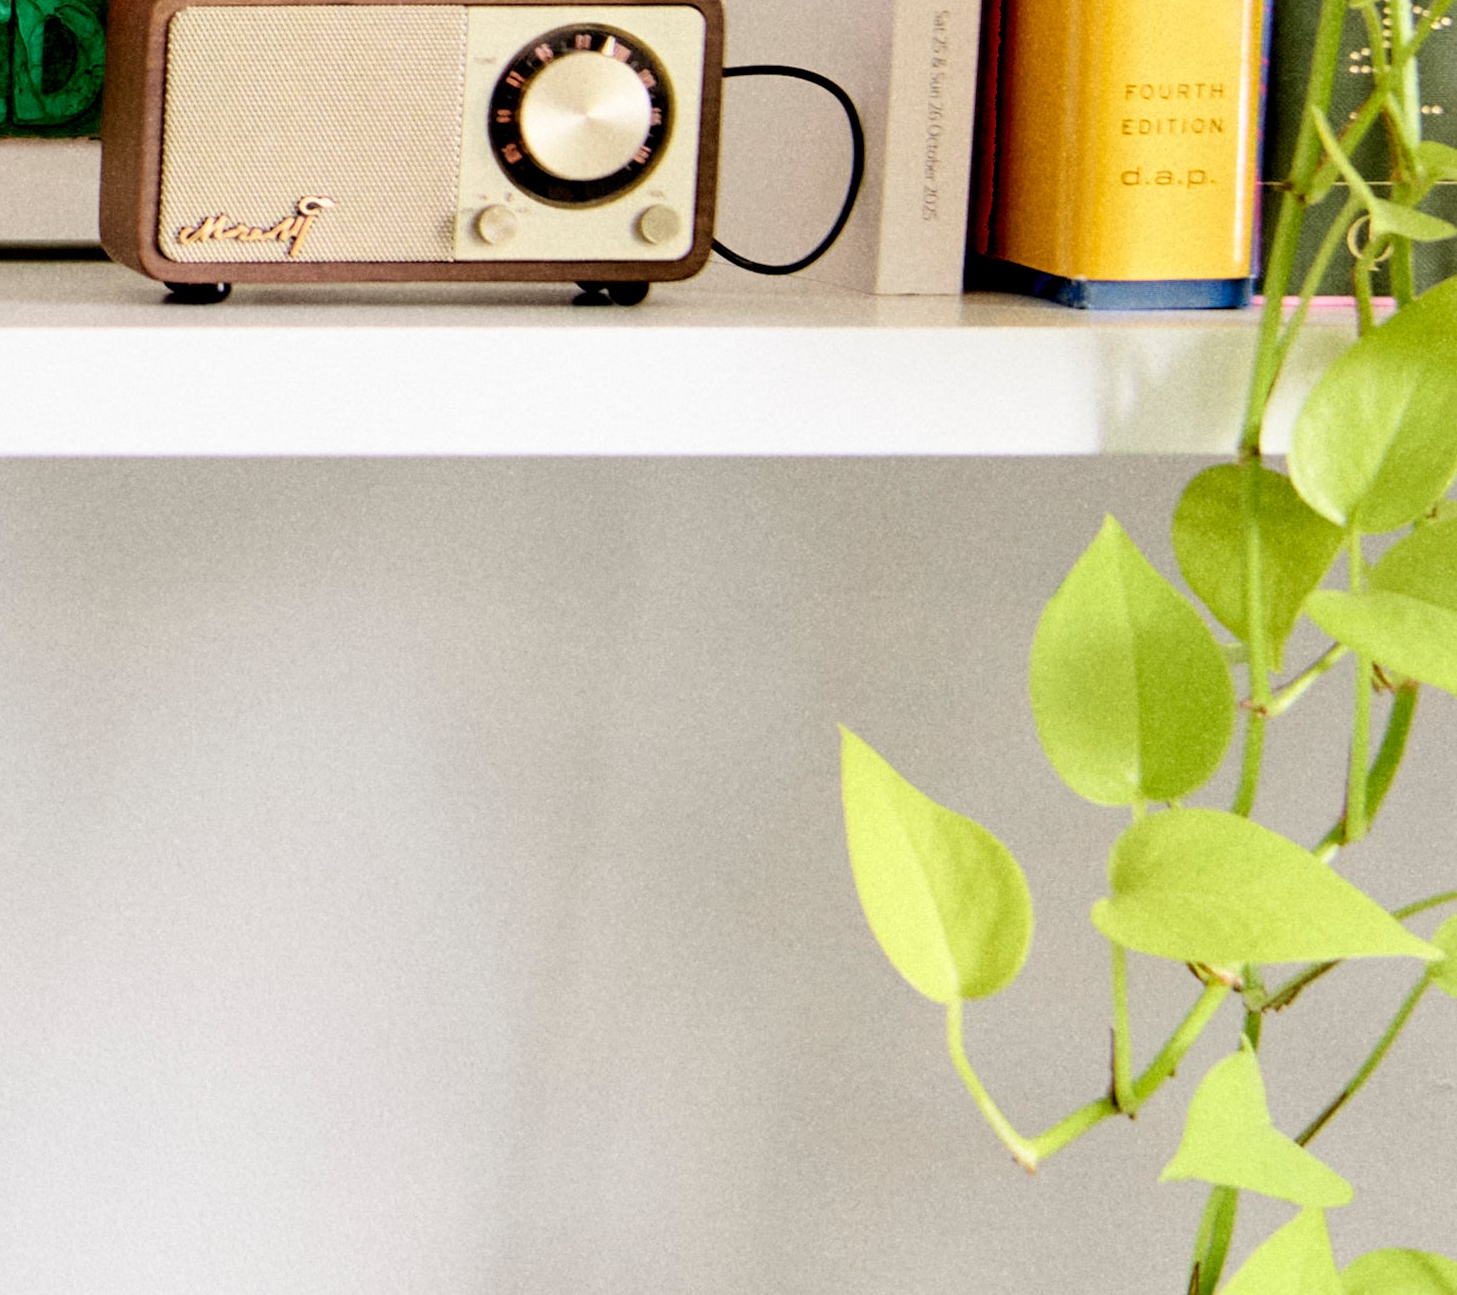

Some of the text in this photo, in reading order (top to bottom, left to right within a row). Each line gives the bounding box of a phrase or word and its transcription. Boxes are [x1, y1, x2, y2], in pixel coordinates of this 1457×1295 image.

[1124, 82, 1226, 102] FOURTH
[1121, 117, 1225, 136] EDITION
[1119, 166, 1217, 188] d.a.p.
